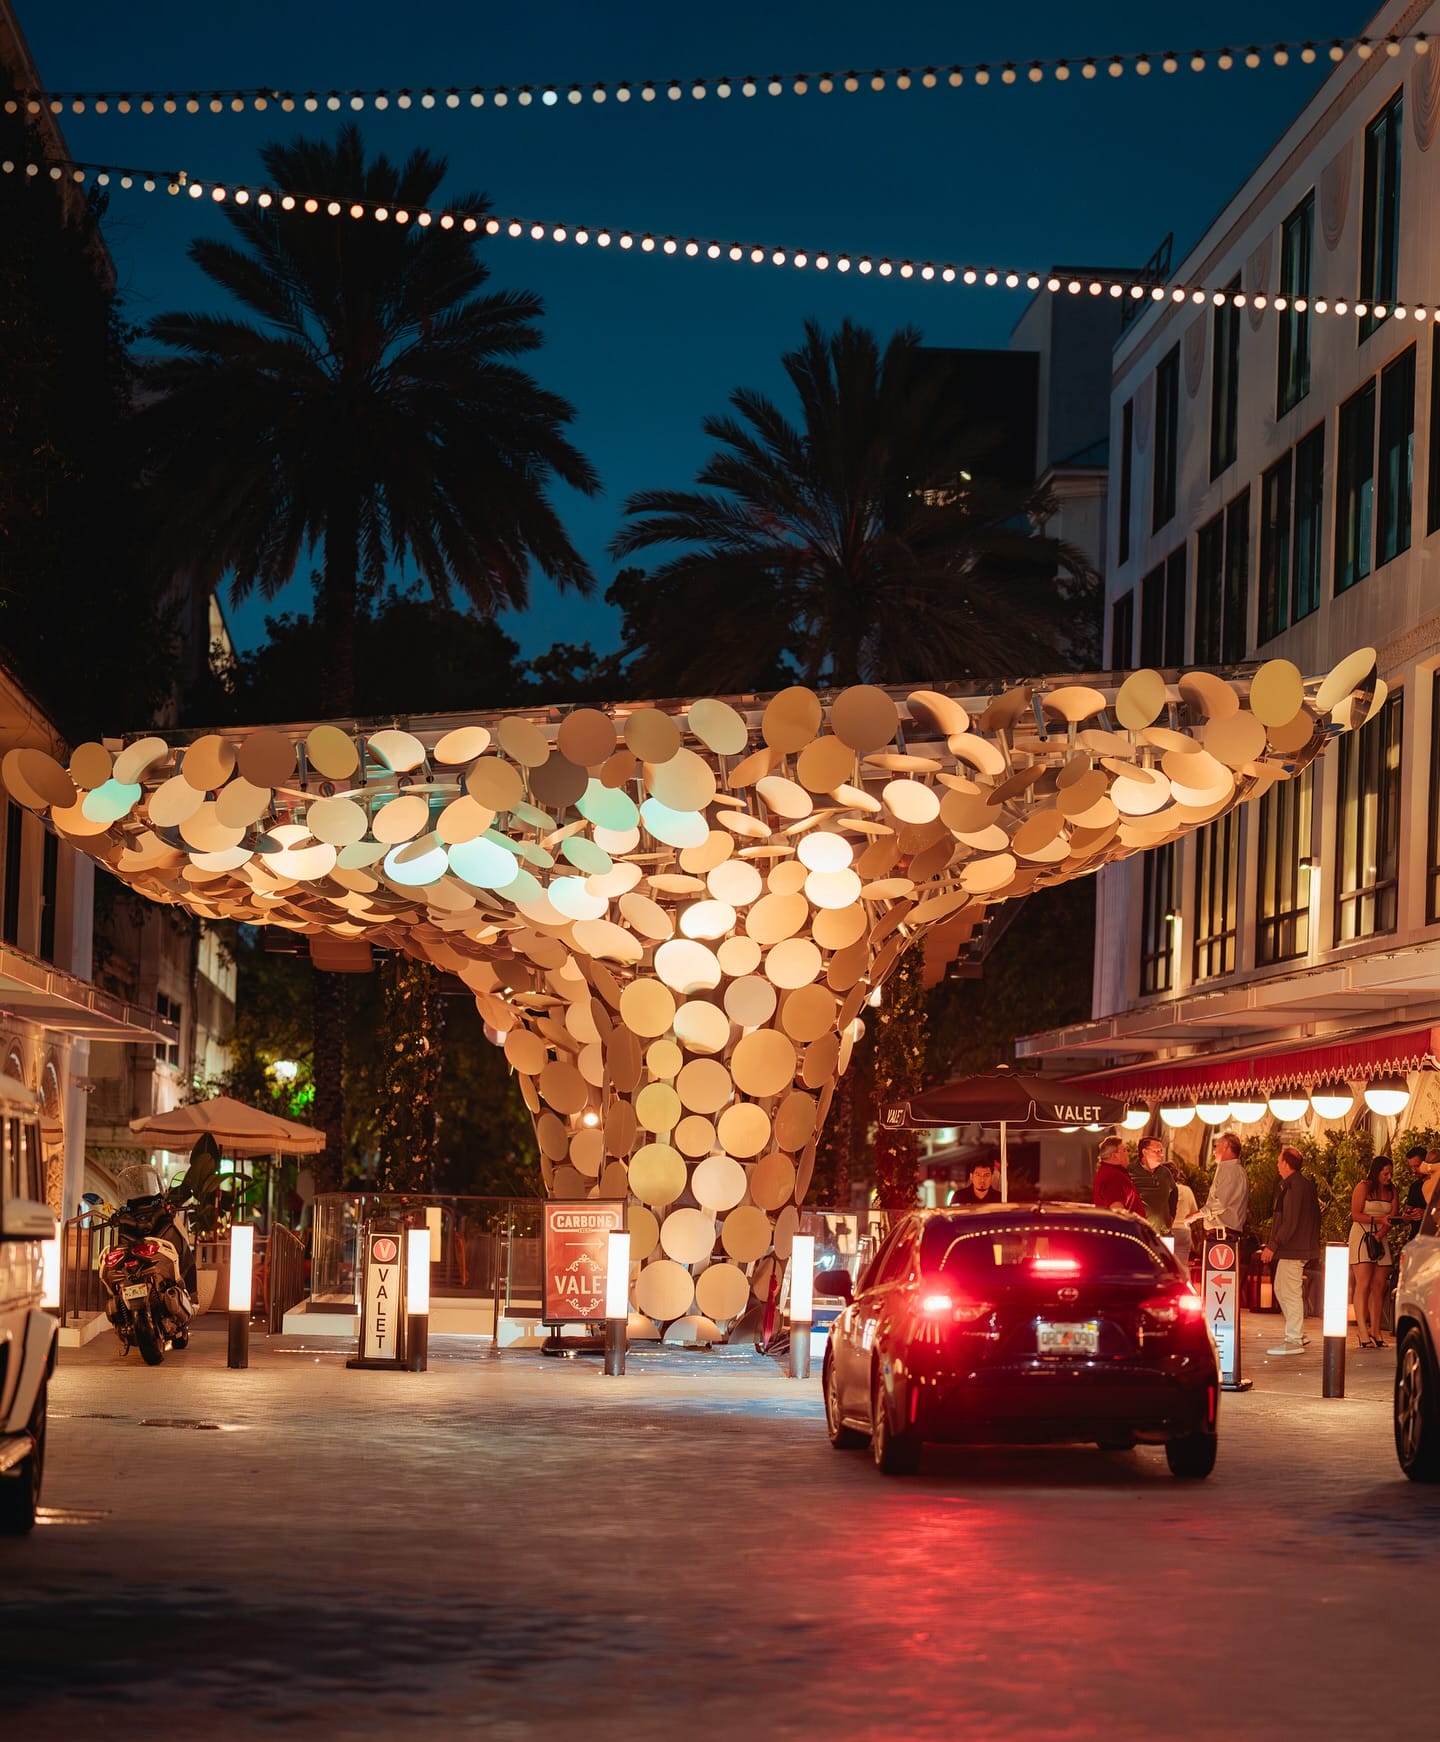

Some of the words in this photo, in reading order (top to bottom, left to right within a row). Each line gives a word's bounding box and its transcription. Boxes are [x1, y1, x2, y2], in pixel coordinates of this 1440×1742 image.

[1054, 1104, 1101, 1120] VALET
[556, 1215, 613, 1228] CARBONE
[379, 1242, 391, 1258] V
[1215, 1247, 1228, 1266] V
[554, 1275, 607, 1295] VALE
[376, 1268, 389, 1349] VALET
[1214, 1291, 1227, 1359] VALE
